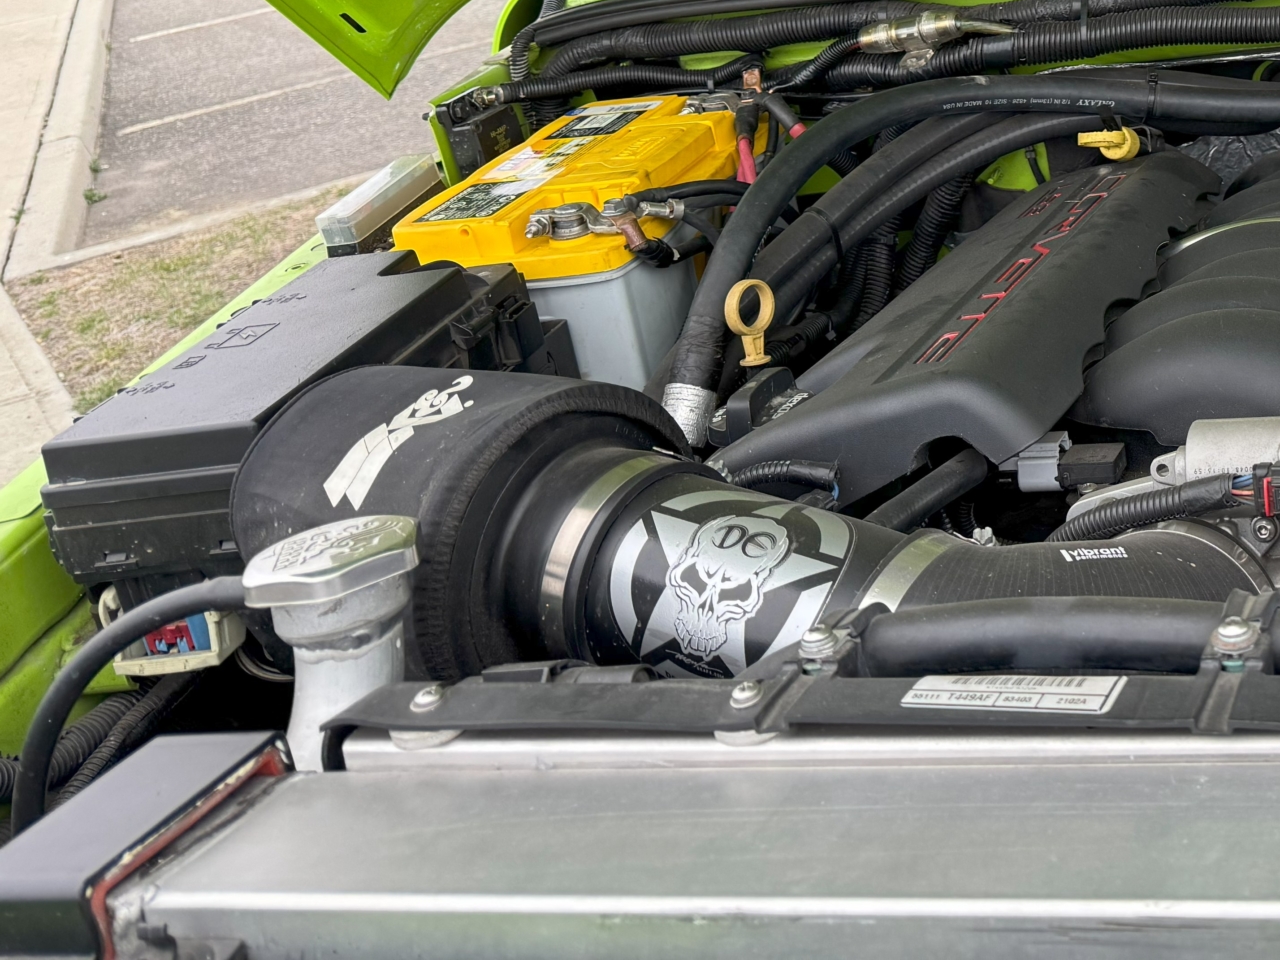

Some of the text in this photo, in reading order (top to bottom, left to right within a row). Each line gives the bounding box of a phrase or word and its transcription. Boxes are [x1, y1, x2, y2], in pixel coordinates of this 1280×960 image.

[1068, 546, 1127, 556] vibrant
[1075, 553, 1129, 561] performance
[1056, 697, 1088, 705] 2102A
